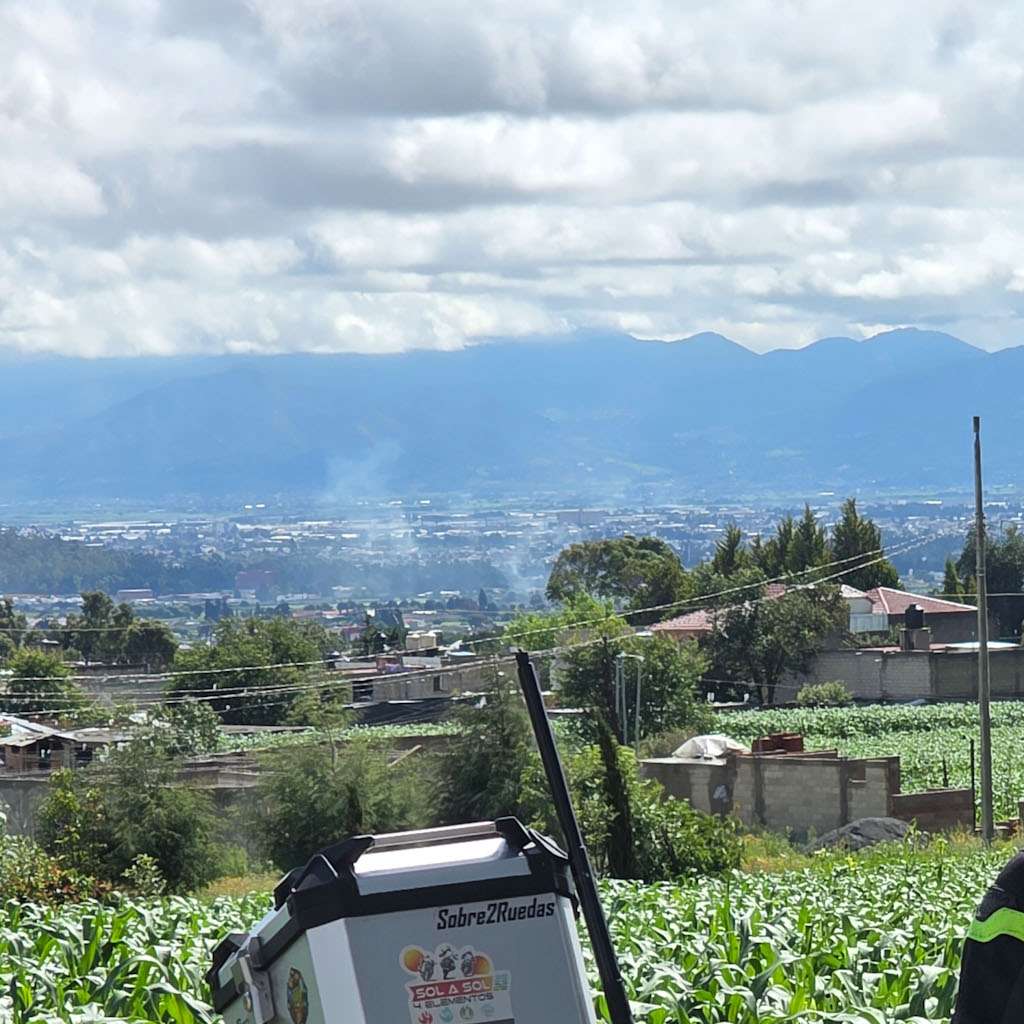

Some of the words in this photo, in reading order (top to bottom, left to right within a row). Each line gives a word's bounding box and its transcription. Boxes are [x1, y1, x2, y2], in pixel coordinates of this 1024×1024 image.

[437, 897, 556, 931] Sobre2Ruedas
[415, 986, 445, 1000] SOL
[448, 984, 459, 995] A
[462, 979, 491, 994] SOL
[424, 992, 494, 1009] ELEMENTOS
